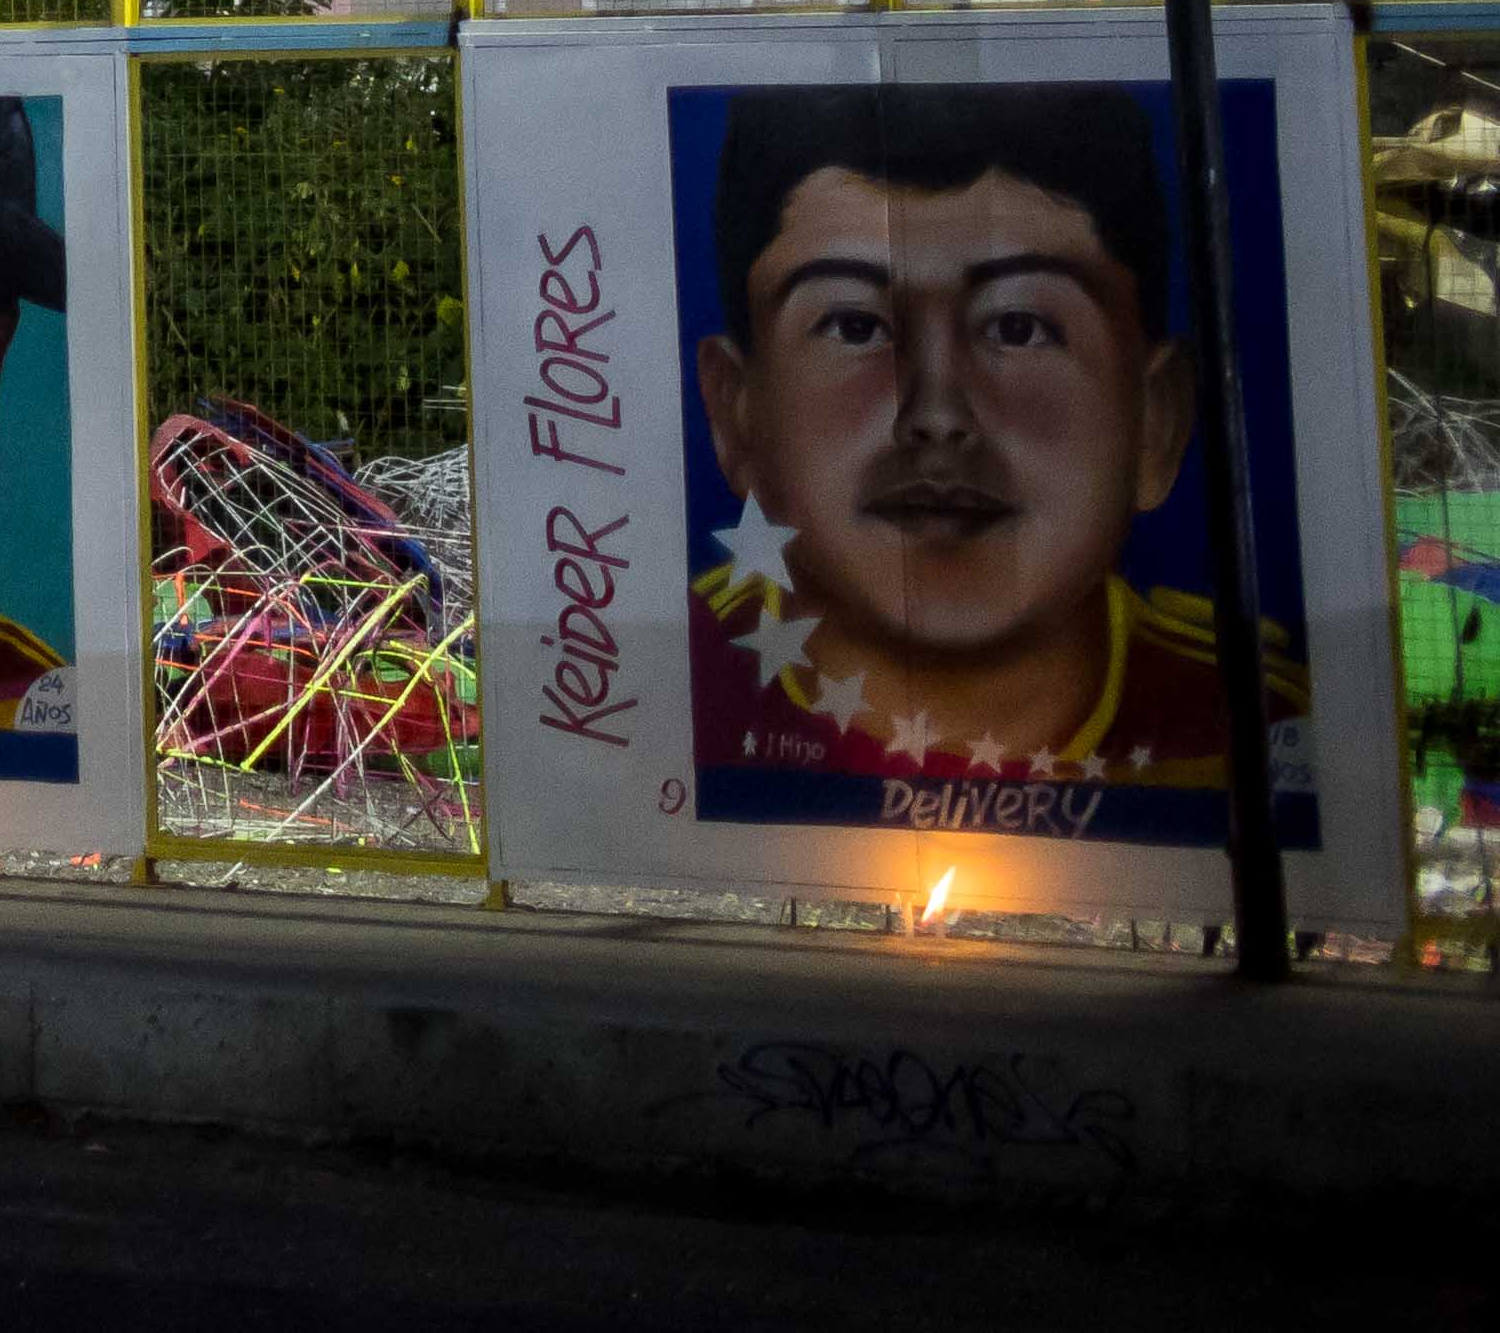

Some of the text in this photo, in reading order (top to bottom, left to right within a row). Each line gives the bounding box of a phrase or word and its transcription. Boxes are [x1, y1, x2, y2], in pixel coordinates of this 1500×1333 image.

[37, 675, 64, 694] 24
[19, 698, 72, 727] AÑOS
[658, 777, 686, 815] 9
